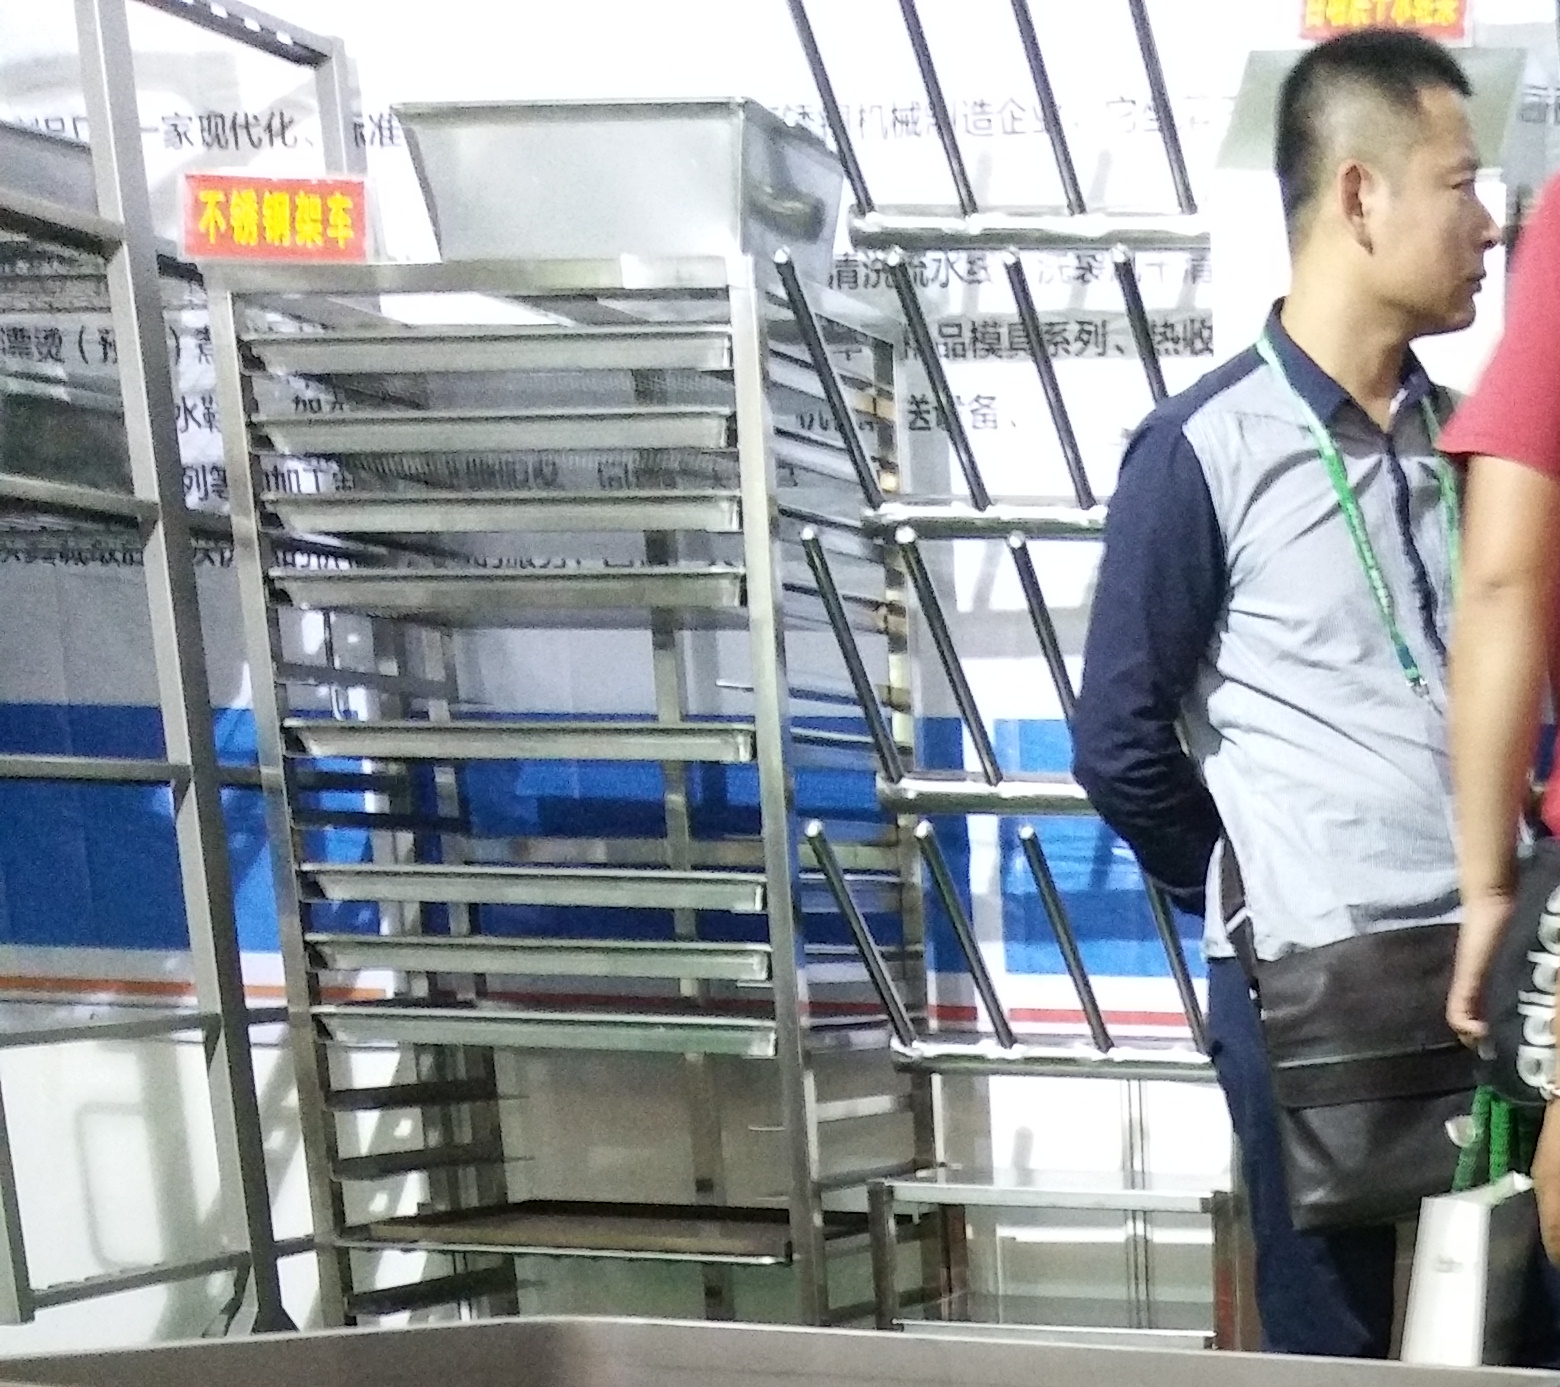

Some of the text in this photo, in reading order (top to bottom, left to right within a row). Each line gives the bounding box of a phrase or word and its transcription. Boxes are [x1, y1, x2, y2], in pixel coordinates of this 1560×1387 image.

[198, 187, 354, 248] 不锈钢架车
